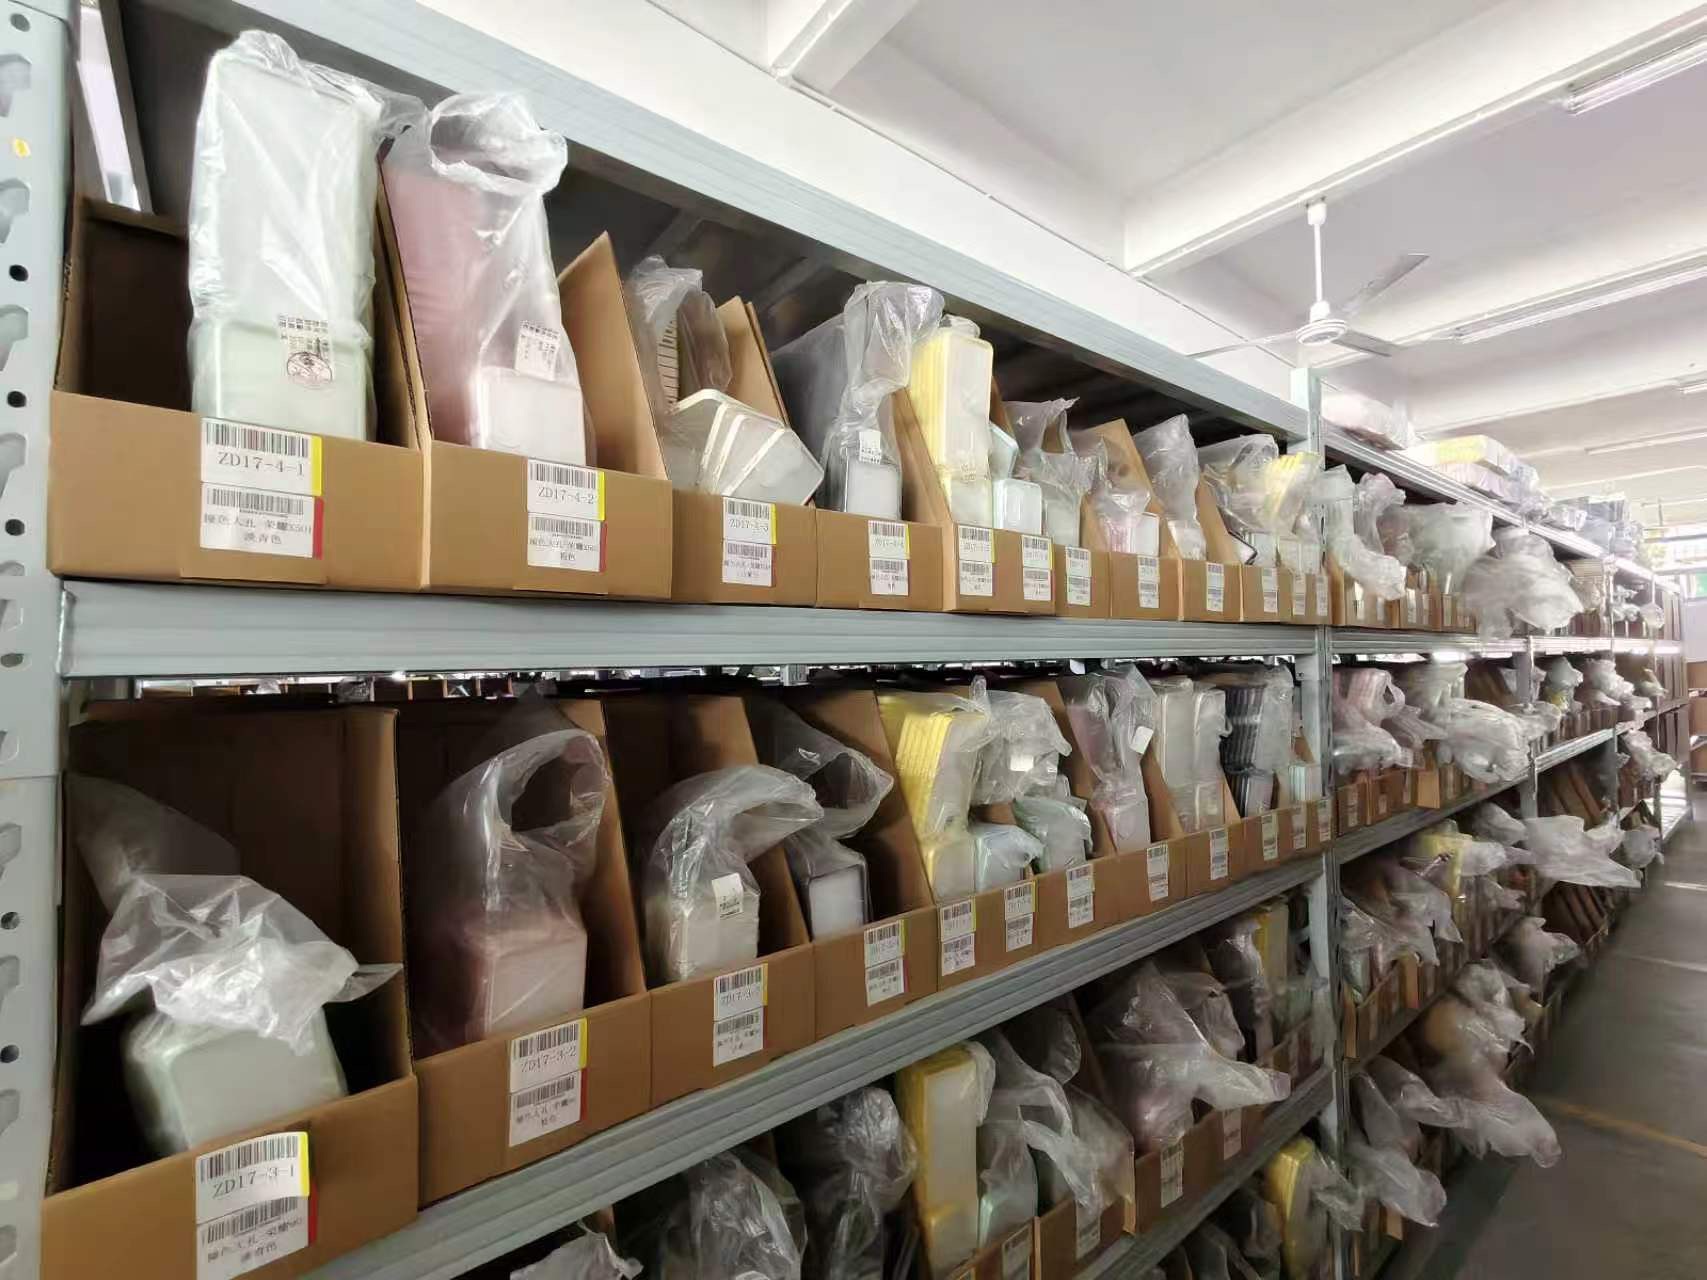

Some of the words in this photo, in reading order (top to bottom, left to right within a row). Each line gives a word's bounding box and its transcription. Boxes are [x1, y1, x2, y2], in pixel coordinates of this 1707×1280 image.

[218, 451, 305, 477] ZD17-4-1
[538, 486, 595, 505] ZD17-4-2
[211, 1163, 295, 1198] ZD17-3-1
